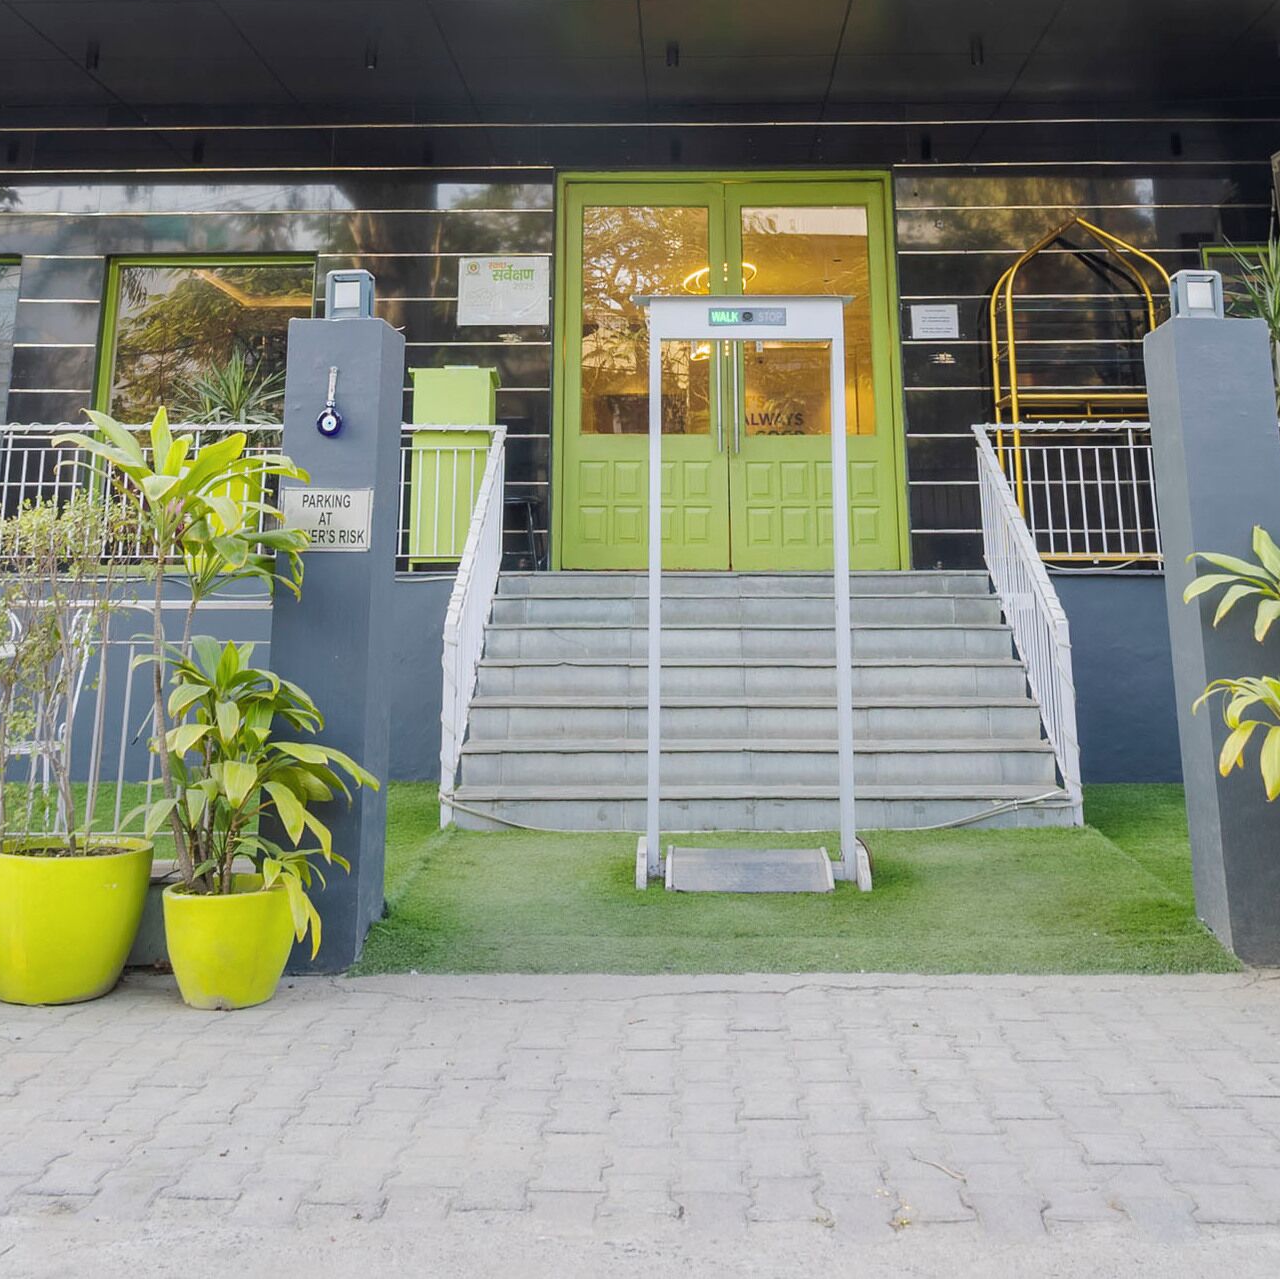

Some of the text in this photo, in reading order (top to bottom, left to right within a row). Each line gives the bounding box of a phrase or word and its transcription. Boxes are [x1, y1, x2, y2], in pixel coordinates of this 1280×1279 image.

[711, 311, 784, 323] WALK STOP
[302, 494, 351, 508] PARKING
[318, 512, 333, 526] AT
[339, 529, 365, 544] RISK
